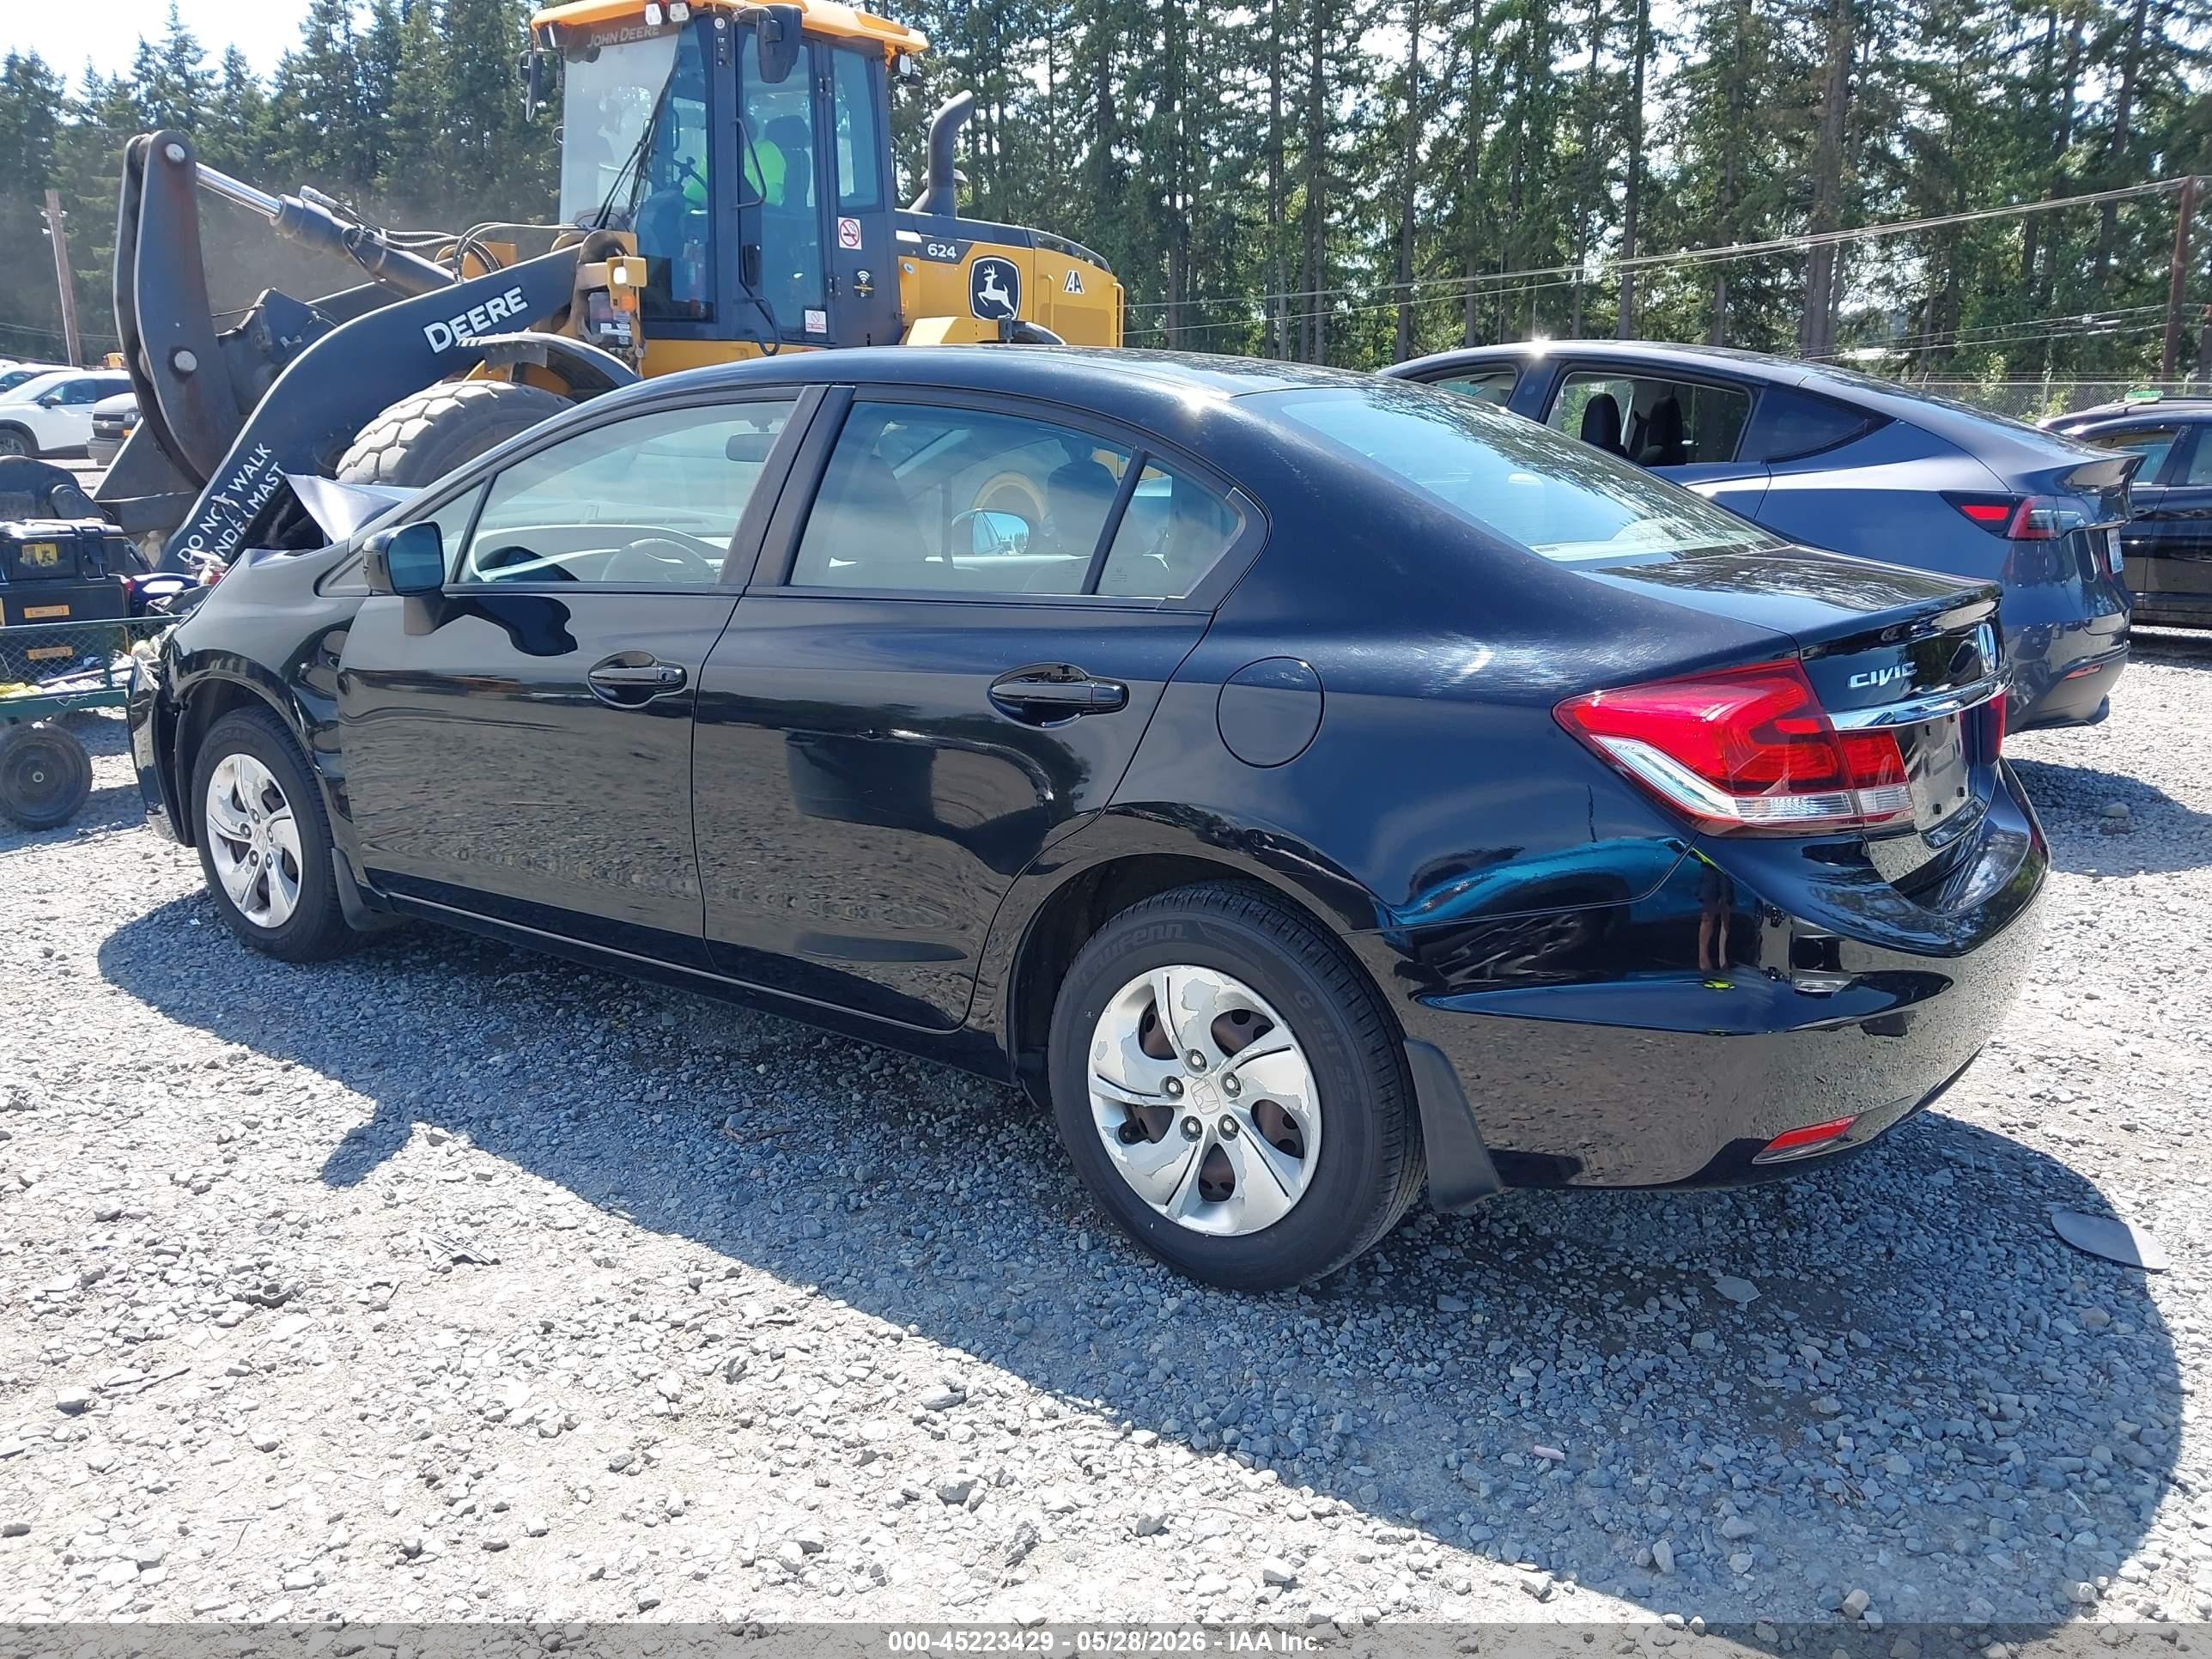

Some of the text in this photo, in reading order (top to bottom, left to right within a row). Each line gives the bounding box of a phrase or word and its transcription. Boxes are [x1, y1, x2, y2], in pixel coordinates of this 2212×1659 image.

[586, 27, 659, 48] JOHN DEERE
[927, 243, 957, 258] 624
[422, 286, 529, 354] DEERE
[177, 534, 204, 562] DO
[228, 442, 272, 492] WALK
[247, 461, 286, 510] MAST
[1850, 661, 1918, 688] CIVIC
